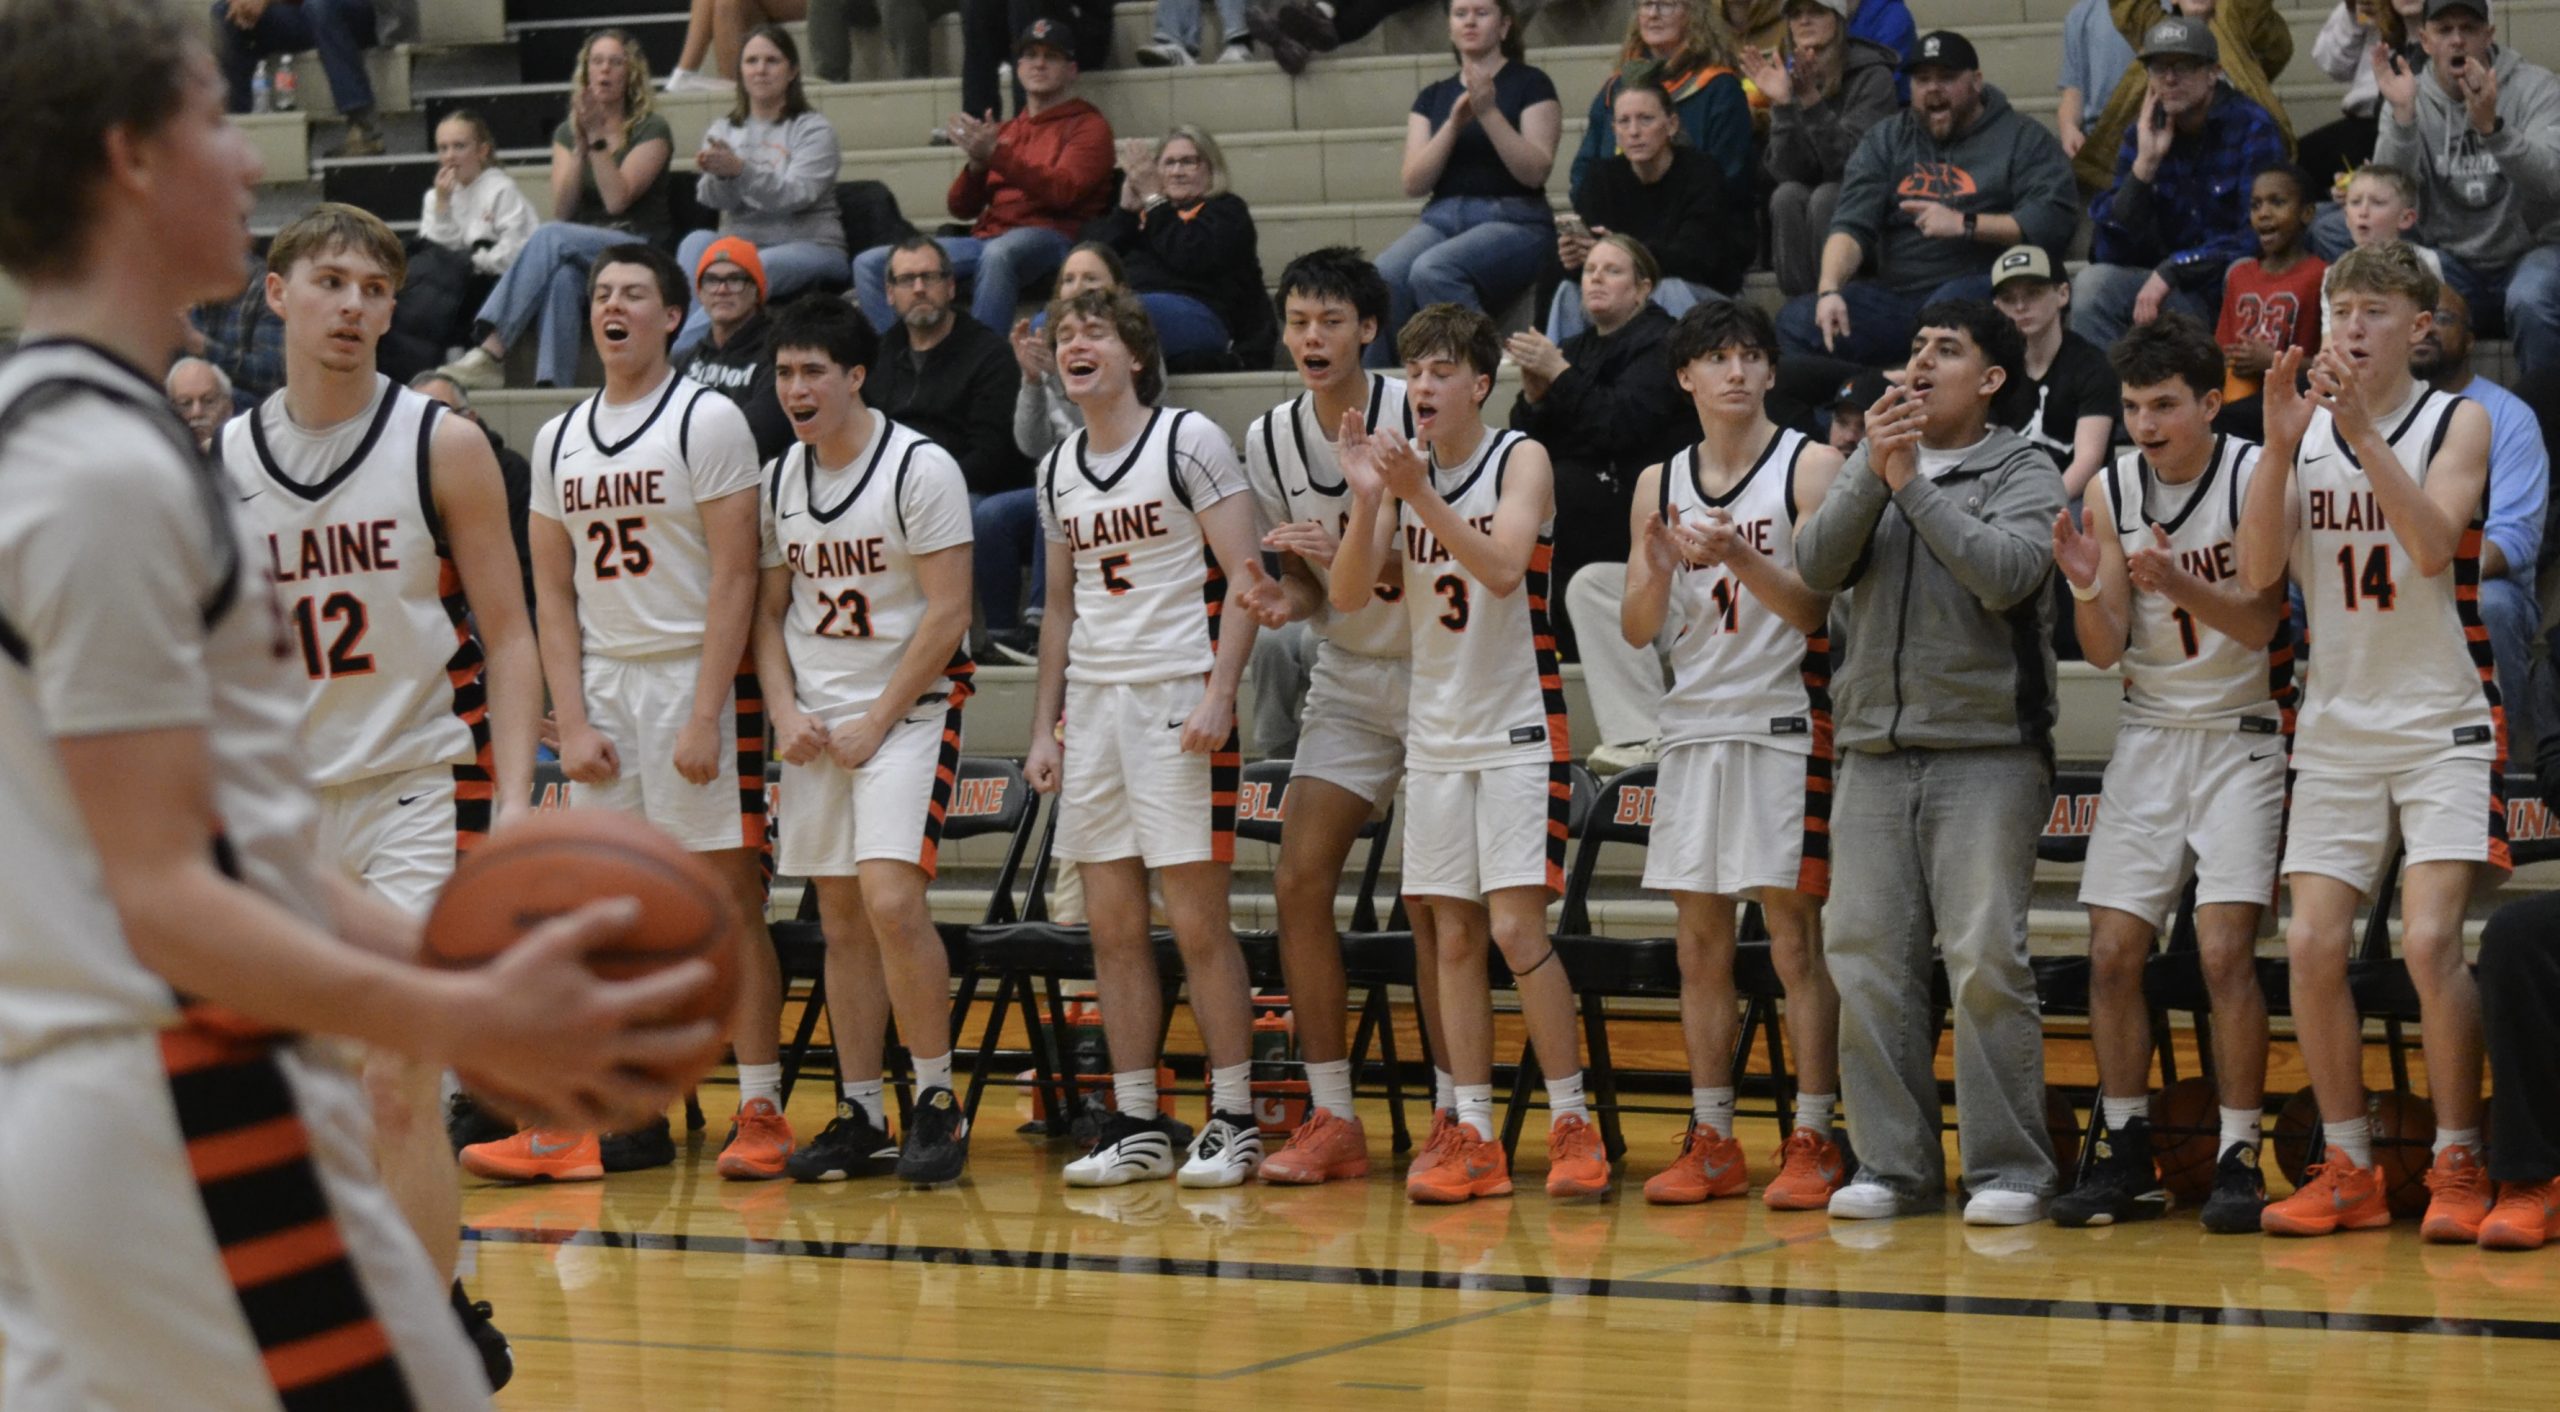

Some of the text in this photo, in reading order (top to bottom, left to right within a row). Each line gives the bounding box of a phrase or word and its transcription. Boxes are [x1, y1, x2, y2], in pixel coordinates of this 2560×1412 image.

[563, 469, 667, 515] BLAINE
[2309, 489, 2386, 531] BLAI
[267, 518, 400, 584] LAINE
[586, 515, 655, 582] 25
[1099, 551, 1136, 597] 5
[2336, 543, 2398, 612] 14
[814, 588, 875, 638] 23
[1433, 572, 1471, 634] 3
[291, 589, 377, 681] 12
[2171, 605, 2200, 660] 1
